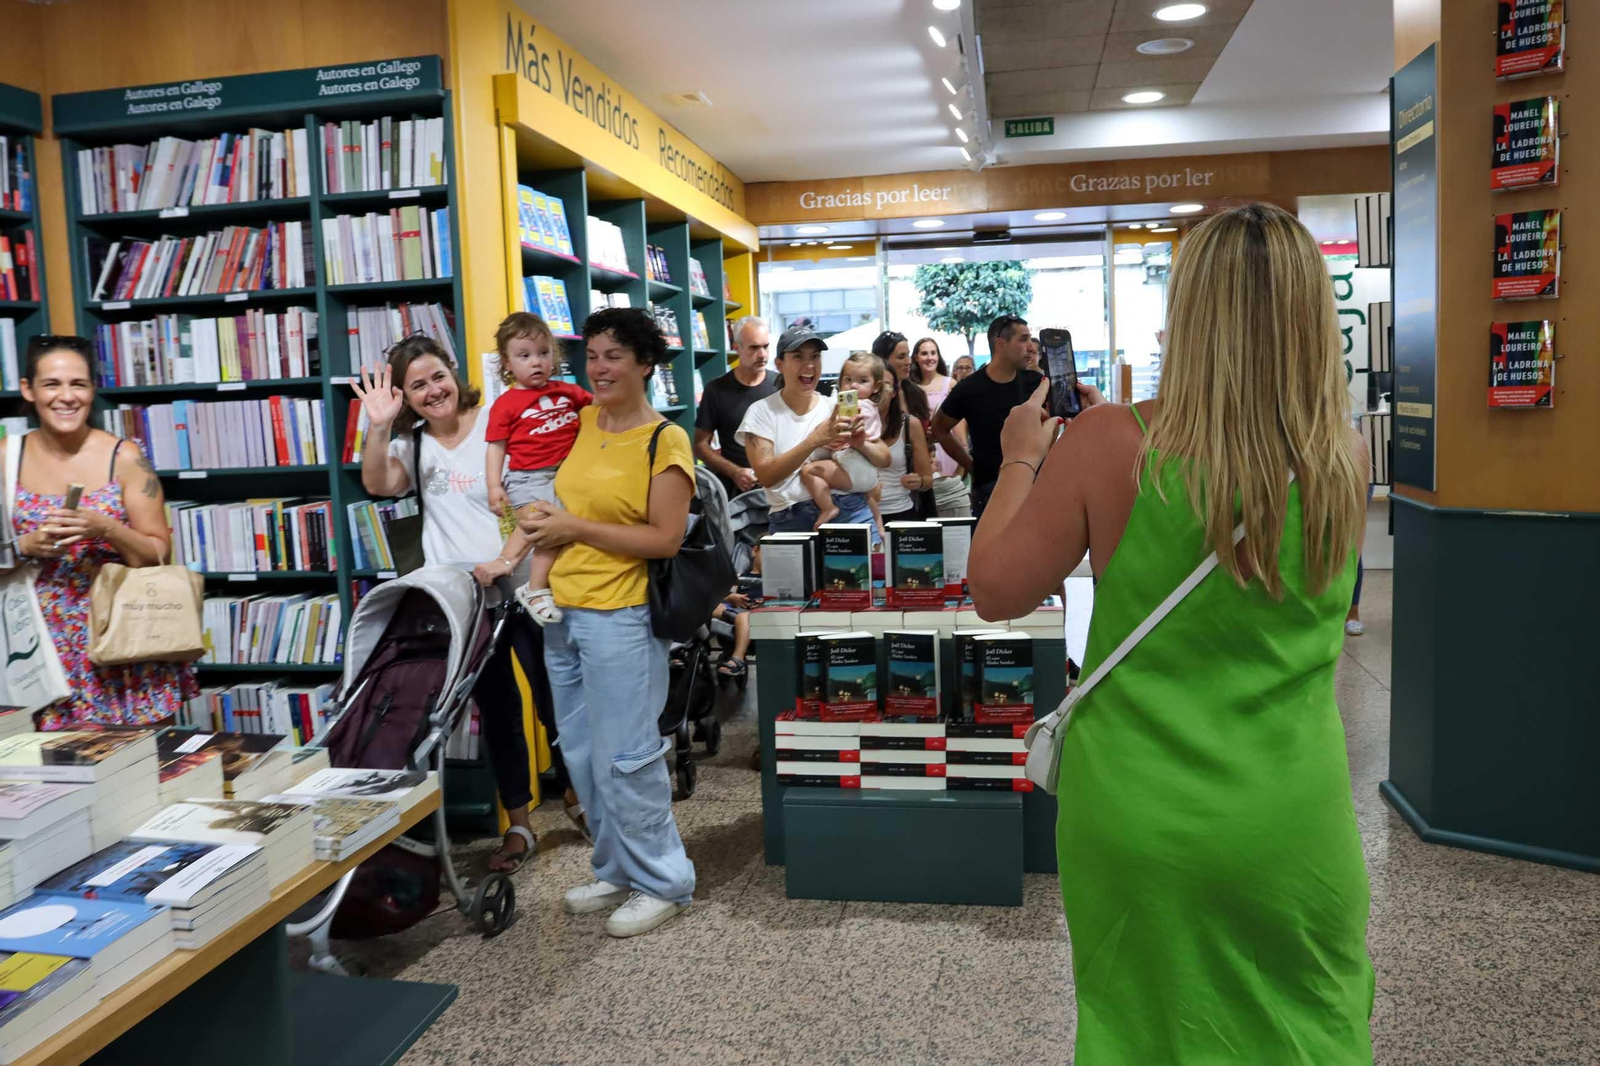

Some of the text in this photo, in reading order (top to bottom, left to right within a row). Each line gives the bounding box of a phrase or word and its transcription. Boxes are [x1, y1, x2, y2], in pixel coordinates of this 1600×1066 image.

[1509, 4, 1552, 20] LOUREIRO
[1502, 22, 1558, 39] LA LADRONA
[1506, 33, 1554, 50] DE HUESOS
[316, 60, 421, 81] Autores en Gallego
[318, 76, 420, 96] Autores en Galego
[506, 12, 640, 151] Más Vendidos
[124, 80, 222, 100] Autores en Gallego
[127, 96, 221, 115] Autores en Galego
[1399, 94, 1432, 129] Directorio
[1510, 108, 1539, 120] MANEL
[1009, 121, 1050, 135] SALIDA
[1504, 118, 1546, 132] LOUREIRO
[1496, 136, 1553, 151] LA LADRONA
[1500, 148, 1548, 161] DE HUESOS
[659, 126, 735, 212] Recomendados
[1070, 168, 1214, 194] Grazas por ler
[800, 184, 952, 210] Gracias por leer
[1512, 221, 1541, 231] MANEL
[1506, 231, 1547, 243] LOUREIRO
[1498, 249, 1554, 261] LA LADRONA
[1502, 261, 1548, 272] DE HUESOS
[1508, 331, 1536, 340] MANEL
[1501, 342, 1542, 352] LOUREIRO
[1493, 360, 1549, 370] LA LADRONA
[1498, 372, 1544, 381] DE HUESOS
